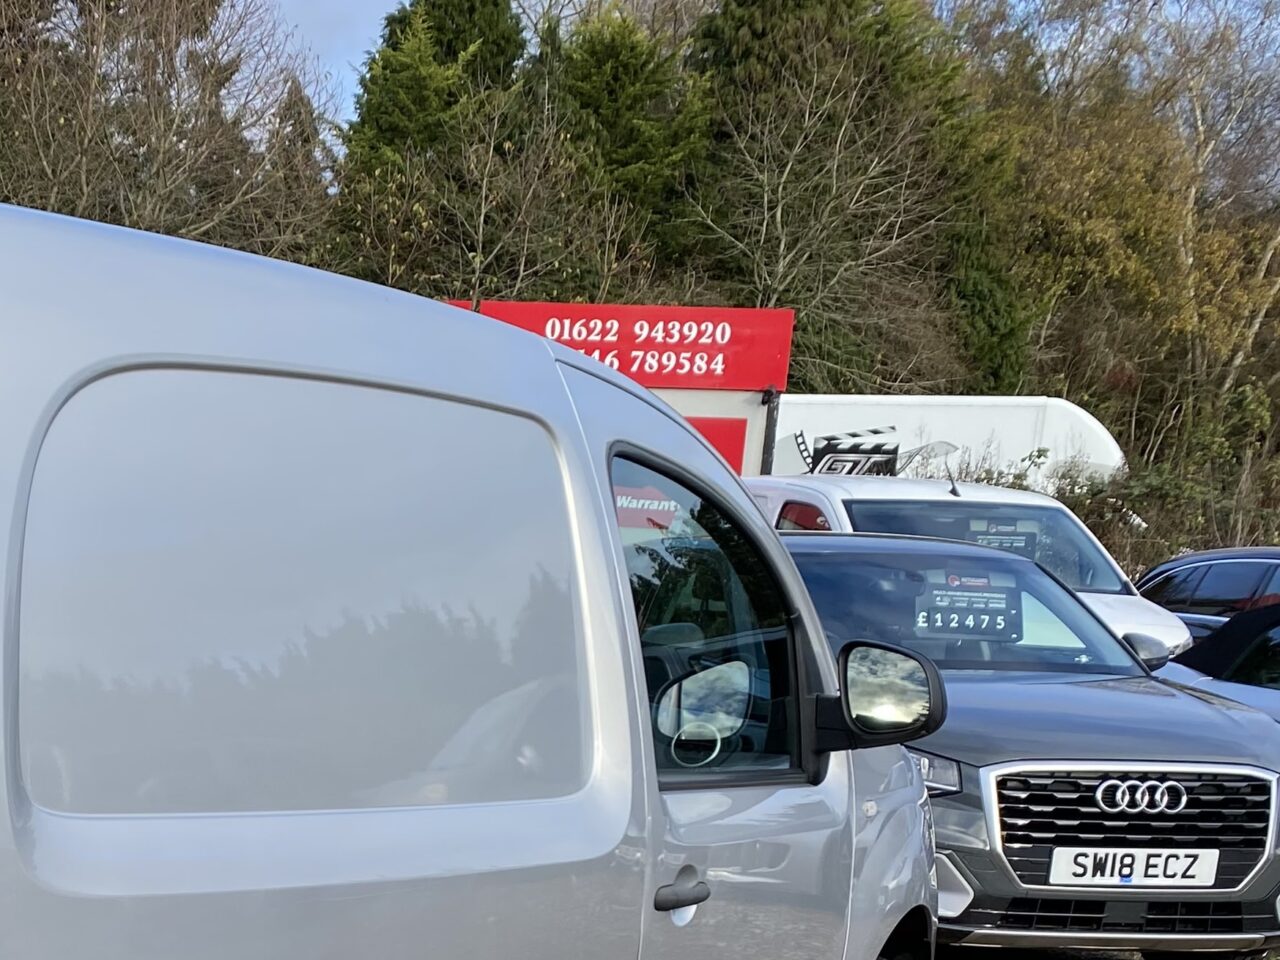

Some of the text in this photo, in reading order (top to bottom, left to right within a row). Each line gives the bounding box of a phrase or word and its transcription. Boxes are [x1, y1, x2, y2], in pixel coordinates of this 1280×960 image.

[545, 317, 732, 345] 01622 943920
[630, 351, 726, 375] 789584
[1072, 852, 1200, 880] SW18 ECZ
